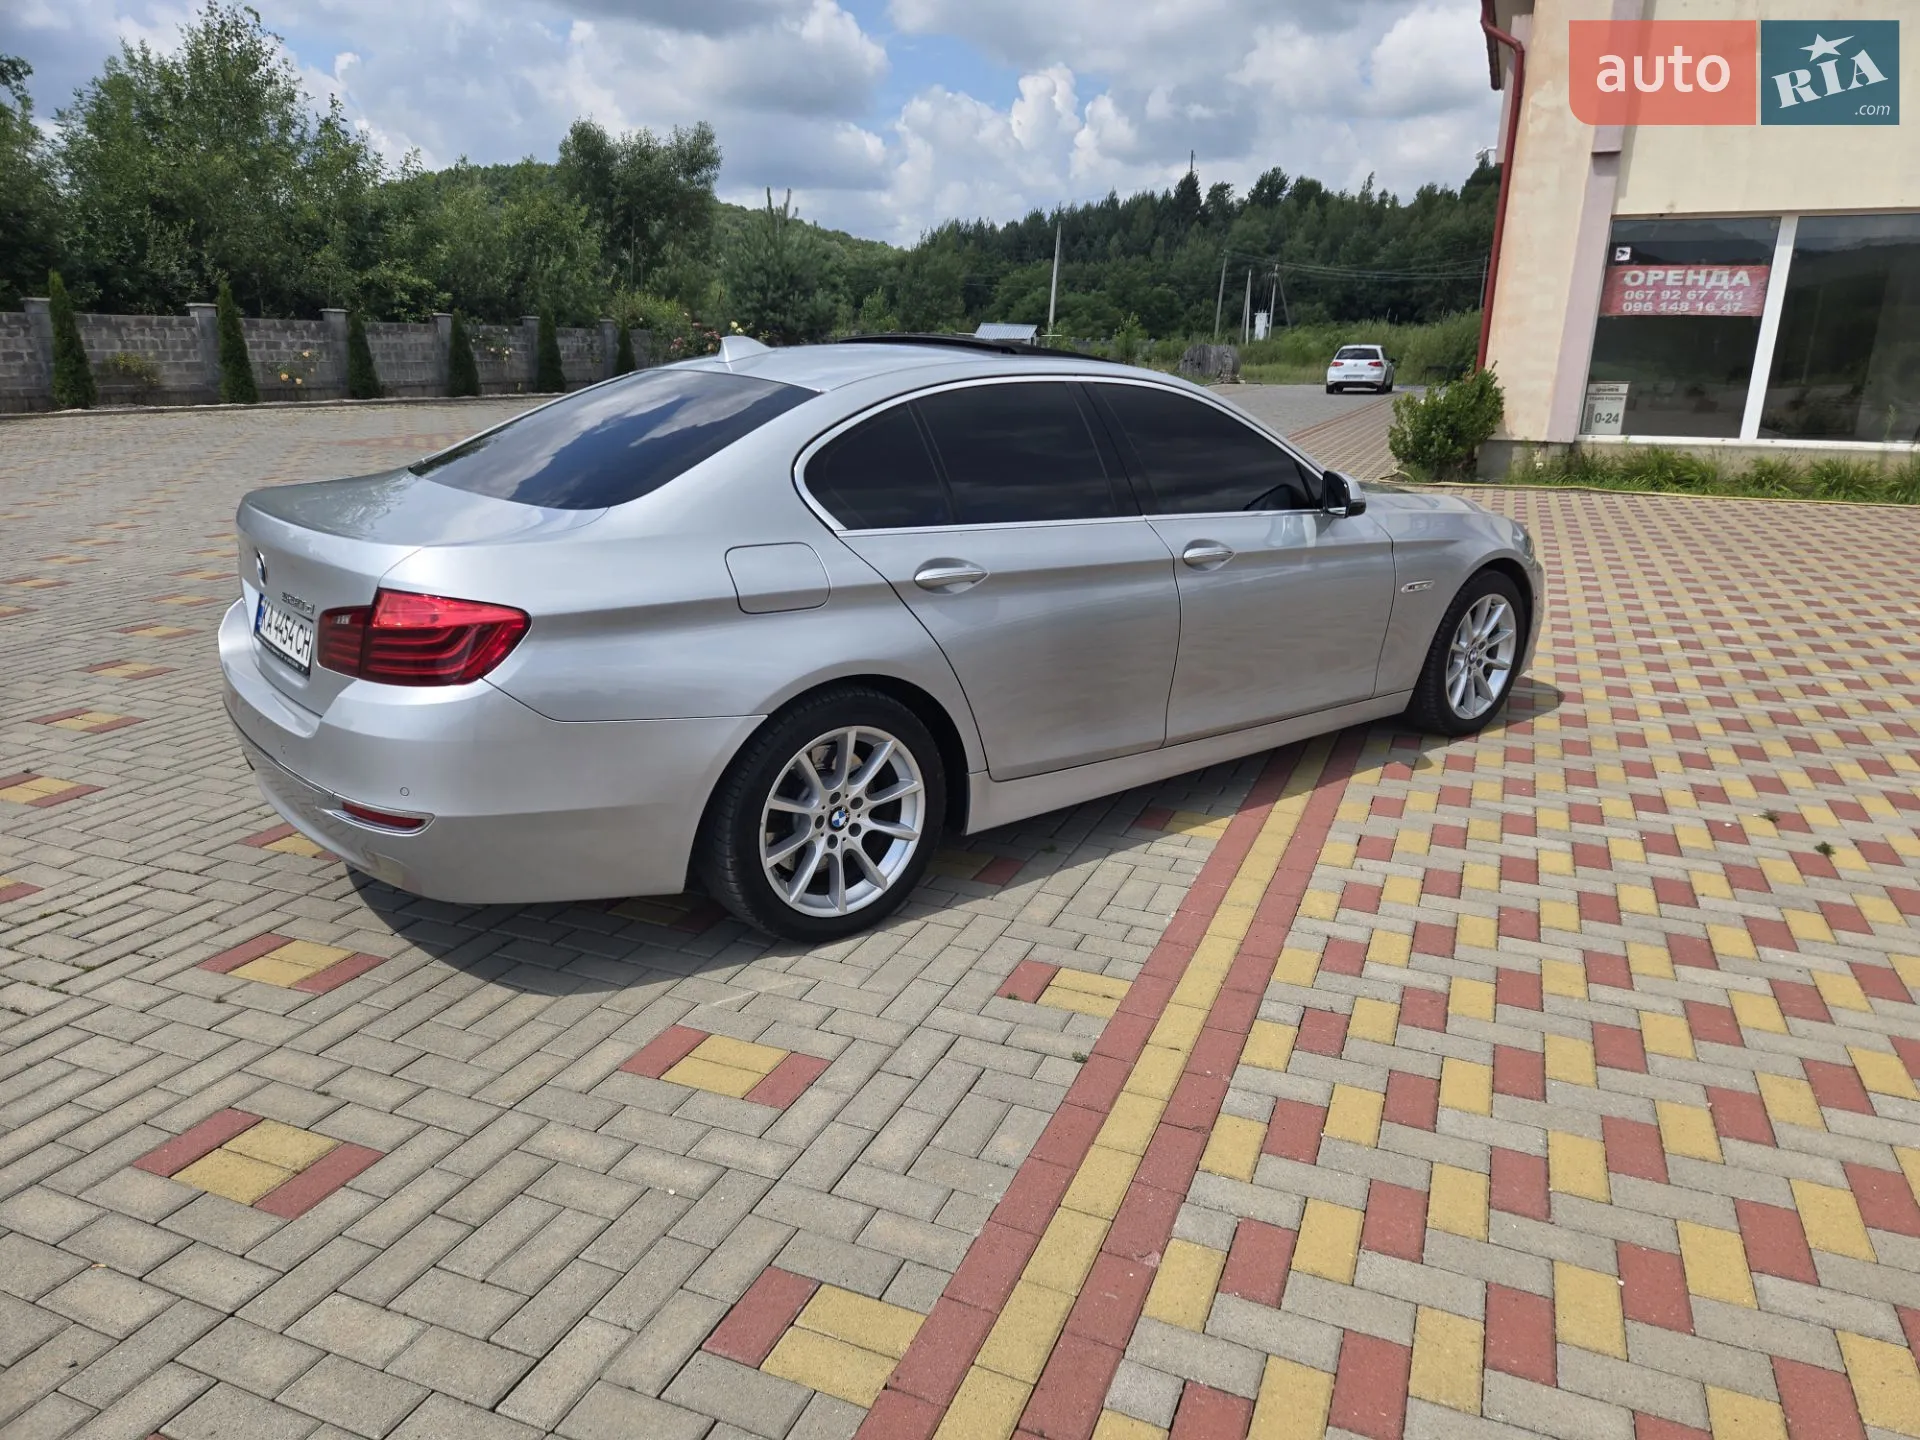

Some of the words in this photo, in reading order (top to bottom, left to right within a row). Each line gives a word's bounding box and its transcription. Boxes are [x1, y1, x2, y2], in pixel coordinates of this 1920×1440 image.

[1623, 269, 1751, 290] ОРЕНДА
[1624, 290, 1656, 300] 067
[1660, 290, 1681, 300] 92
[1686, 290, 1708, 300] 67
[1622, 302, 1653, 312] 096
[1659, 302, 1690, 312] 148
[1695, 302, 1715, 312] 16
[1594, 412, 1620, 424] 0-24
[274, 608, 297, 650] 4454
[295, 623, 312, 661] CH
